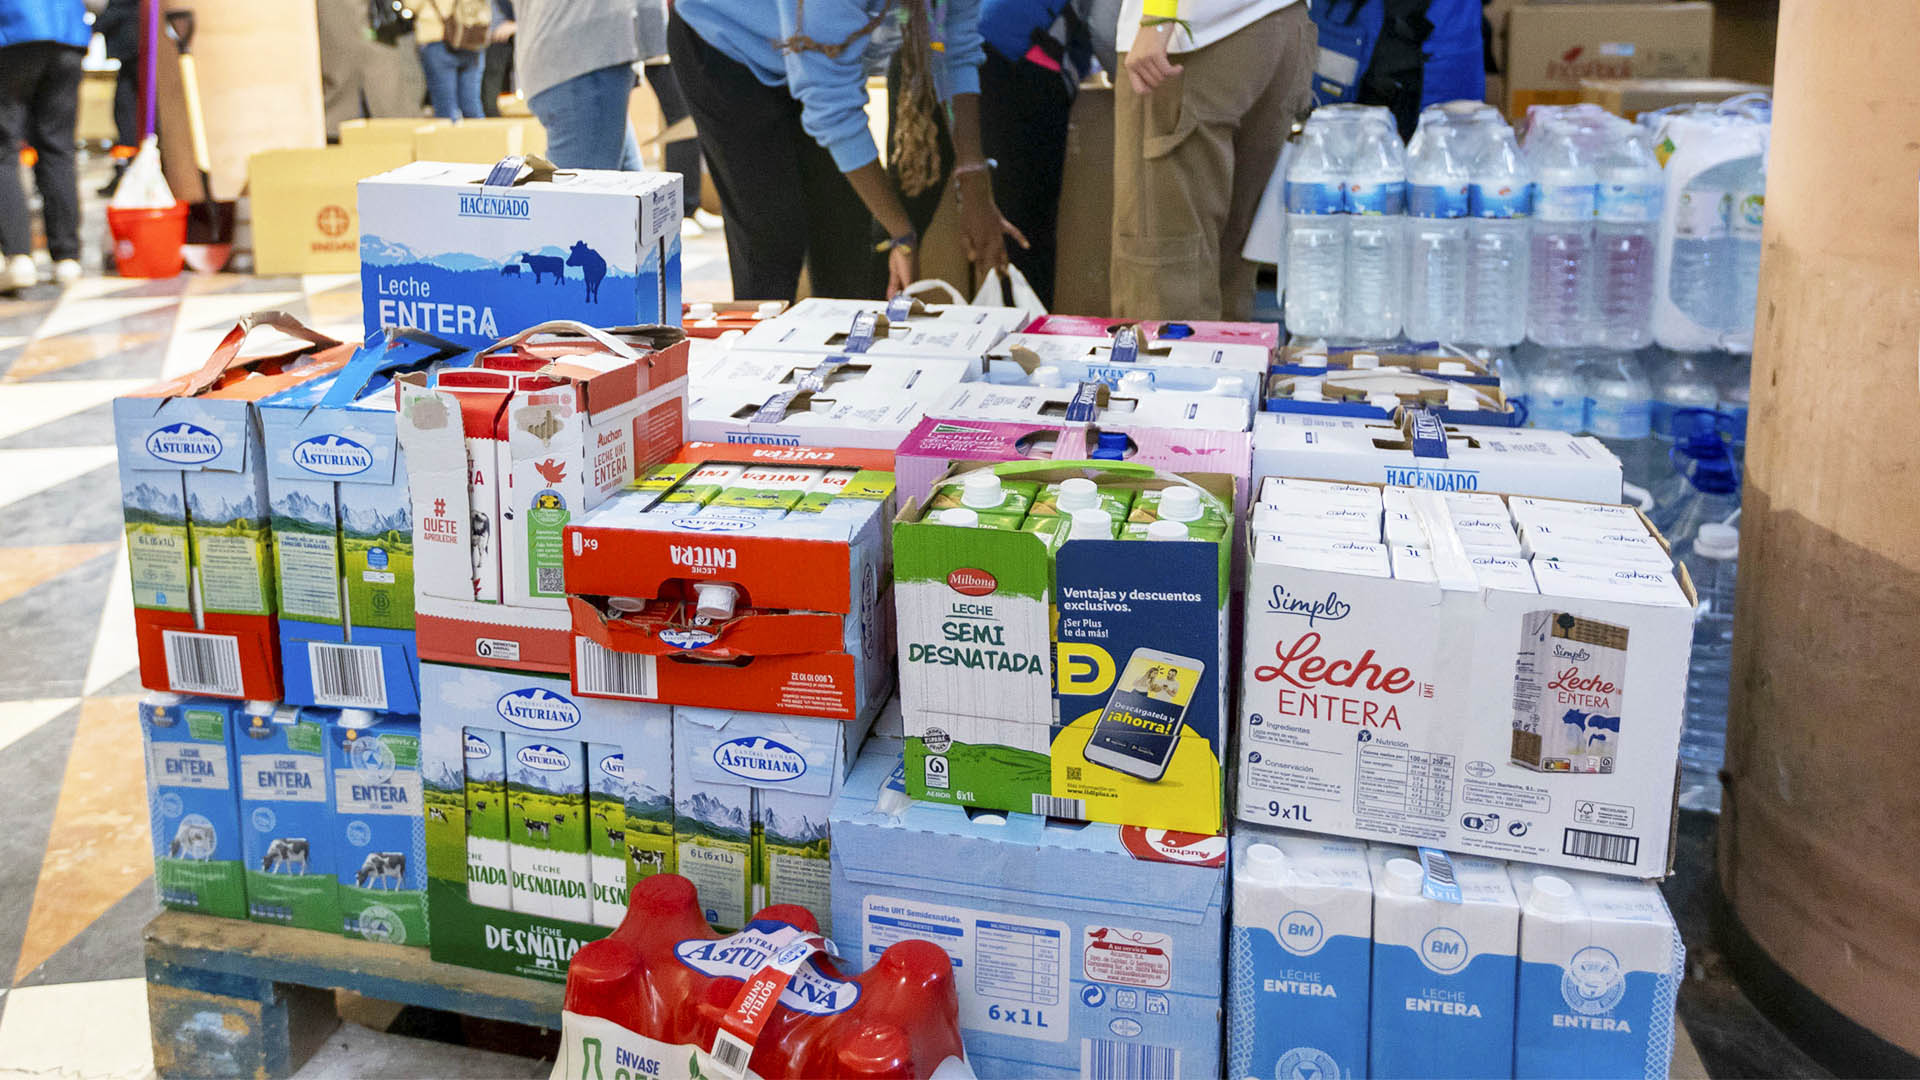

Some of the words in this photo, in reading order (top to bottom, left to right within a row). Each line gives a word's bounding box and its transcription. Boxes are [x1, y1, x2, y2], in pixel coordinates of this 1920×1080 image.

[460, 196, 529, 217] HACENDADO
[378, 274, 430, 297] Leche
[379, 300, 499, 339] ENTERA
[598, 429, 623, 448] Auchan
[153, 441, 217, 456] ASTURIANA
[300, 448, 367, 467] ASTURIANA
[594, 448, 613, 468] LECHE
[594, 456, 627, 487] ENTERA
[1386, 470, 1478, 491] HACENDADO
[424, 517, 457, 534] QUETE
[584, 538, 598, 550] 6x
[669, 544, 737, 569] ENTERA
[691, 566, 718, 575] LECHE
[950, 572, 996, 588] Milbona
[1063, 587, 1117, 601] Ventajas
[1119, 591, 1127, 601] y
[1129, 588, 1202, 602] descuentos
[952, 603, 993, 616] LECHE
[1064, 600, 1132, 612] exclusivos.
[1064, 618, 1081, 629] ¡Ser
[1082, 618, 1102, 628] Plus
[942, 622, 1005, 646] SEMI
[1064, 629, 1074, 637] te
[1074, 629, 1087, 637] da
[1087, 629, 1109, 638] más!
[908, 643, 1043, 675] DESNATADA
[1254, 632, 1415, 695] Leche
[1548, 667, 1615, 695] Leche
[1278, 689, 1402, 730] ENTERA
[1558, 692, 1610, 709] ENTERA
[504, 700, 574, 724] ASTURIANA
[1114, 701, 1168, 721] Descárgatela
[1107, 711, 1173, 735] ¡ahorra!
[1266, 721, 1311, 735] Ingredientes
[1376, 738, 1409, 748] Nutrición
[165, 758, 215, 777] ENTERA
[521, 751, 566, 767] ASTURIANA
[721, 749, 800, 774] ASTURIANA
[1265, 759, 1314, 773] Conservación
[258, 771, 312, 789] ENTERA
[352, 785, 408, 803] ENTERA
[957, 790, 976, 802] 6x1L
[1161, 847, 1210, 859] Auchan
[533, 864, 561, 874] LECHE
[512, 870, 586, 899] DESNATADA
[891, 907, 905, 915] UHT
[530, 925, 562, 936] LECHE
[1288, 923, 1315, 936] BM
[1431, 940, 1459, 956] BM
[1279, 969, 1321, 983] LECHE
[738, 980, 764, 1014] ENTERA
[1264, 979, 1337, 998] ENTERA
[1422, 987, 1466, 1001] LECHE
[744, 980, 777, 1025] BOTELLA
[1405, 998, 1482, 1018] ENTERA
[1553, 1014, 1632, 1034] ENTERA
[616, 1046, 661, 1076] ENVASE
